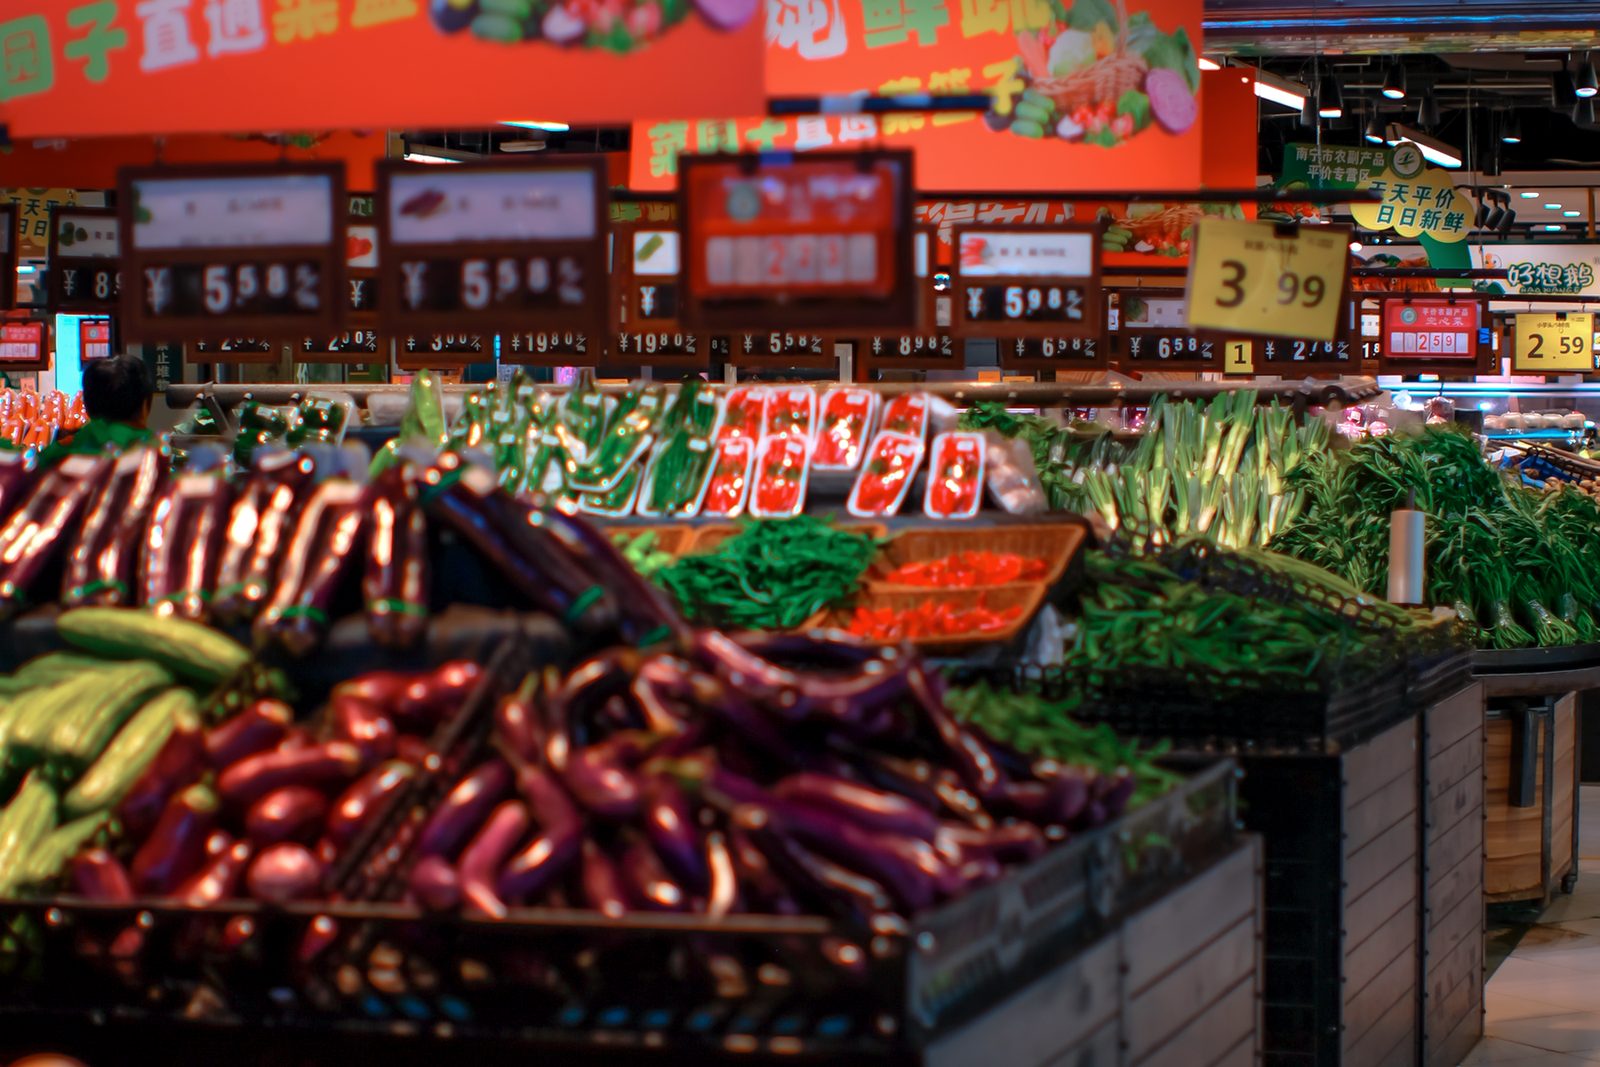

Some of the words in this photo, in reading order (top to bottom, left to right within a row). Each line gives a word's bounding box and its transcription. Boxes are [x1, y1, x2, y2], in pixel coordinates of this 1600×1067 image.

[1295, 146, 1385, 166] 南宁市农副产品
[1377, 205, 1465, 233] 日日新鲜
[1214, 259, 1326, 309] 3.99
[1508, 262, 1594, 288] 好想鹅
[1158, 337, 1197, 359] 6.58
[1234, 344, 1247, 364] 1
[1527, 333, 1584, 359] 2.59
